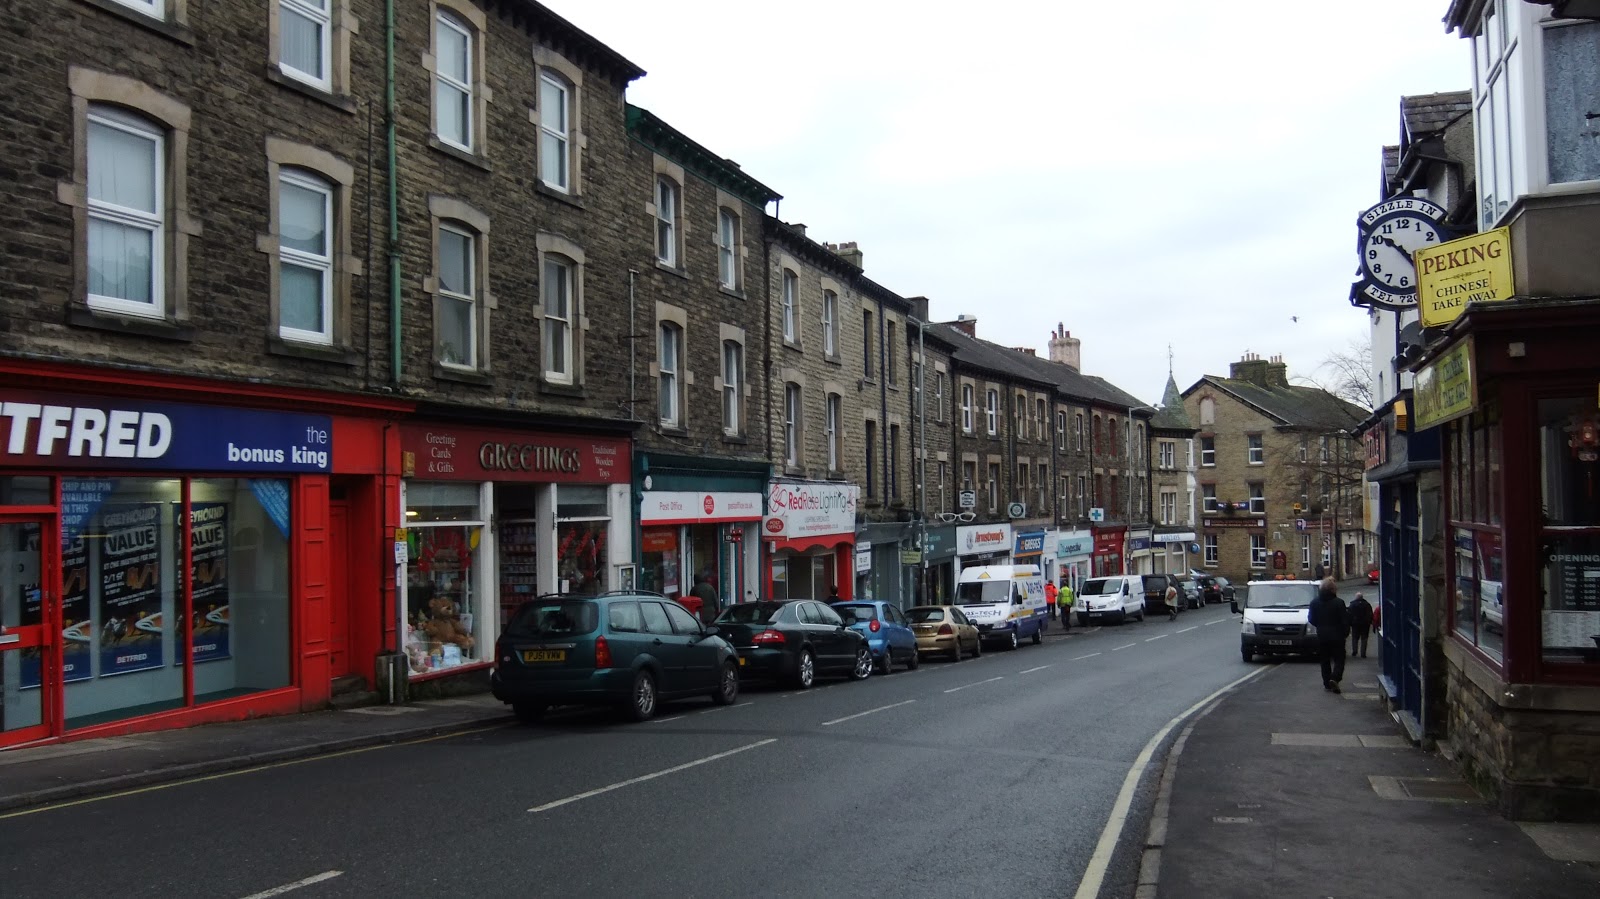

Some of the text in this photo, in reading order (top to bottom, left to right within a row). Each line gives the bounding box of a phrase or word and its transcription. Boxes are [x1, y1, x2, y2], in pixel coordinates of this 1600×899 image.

[1367, 201, 1437, 222] SIZZLE IN
[1382, 224, 1392, 234] 11
[1396, 219, 1409, 229] 12
[1415, 222, 1421, 231] 1
[1371, 235, 1383, 245] 10
[1426, 232, 1434, 241] 2
[1369, 250, 1377, 259] 9
[1422, 240, 1501, 275] PEKING
[1373, 264, 1381, 273] 8
[1385, 274, 1393, 283] 7
[1400, 277, 1408, 286] 6
[1436, 278, 1489, 298] CHINESE
[1370, 287, 1394, 303] TEL
[1432, 288, 1498, 311] TAKE AWAY
[0, 402, 172, 458] TFRED
[306, 426, 327, 444] the
[426, 432, 456, 448] Greeting
[228, 442, 327, 468] bonus king
[431, 447, 451, 458] Cards
[592, 445, 616, 455] Traditional
[480, 443, 580, 472] GREETINGS
[595, 457, 613, 466] Wooden
[428, 462, 454, 473] & Gifts
[599, 468, 610, 479] Toys
[80, 482, 96, 491] AND
[99, 482, 111, 491] PIN
[61, 493, 101, 502] AVAILABLE
[71, 504, 88, 513] THIS
[659, 502, 683, 510] Post Office
[61, 515, 82, 524] SHOP
[108, 528, 153, 553] VALUE
[1549, 554, 1600, 562] OPENING
[117, 653, 148, 664] BETFRED
